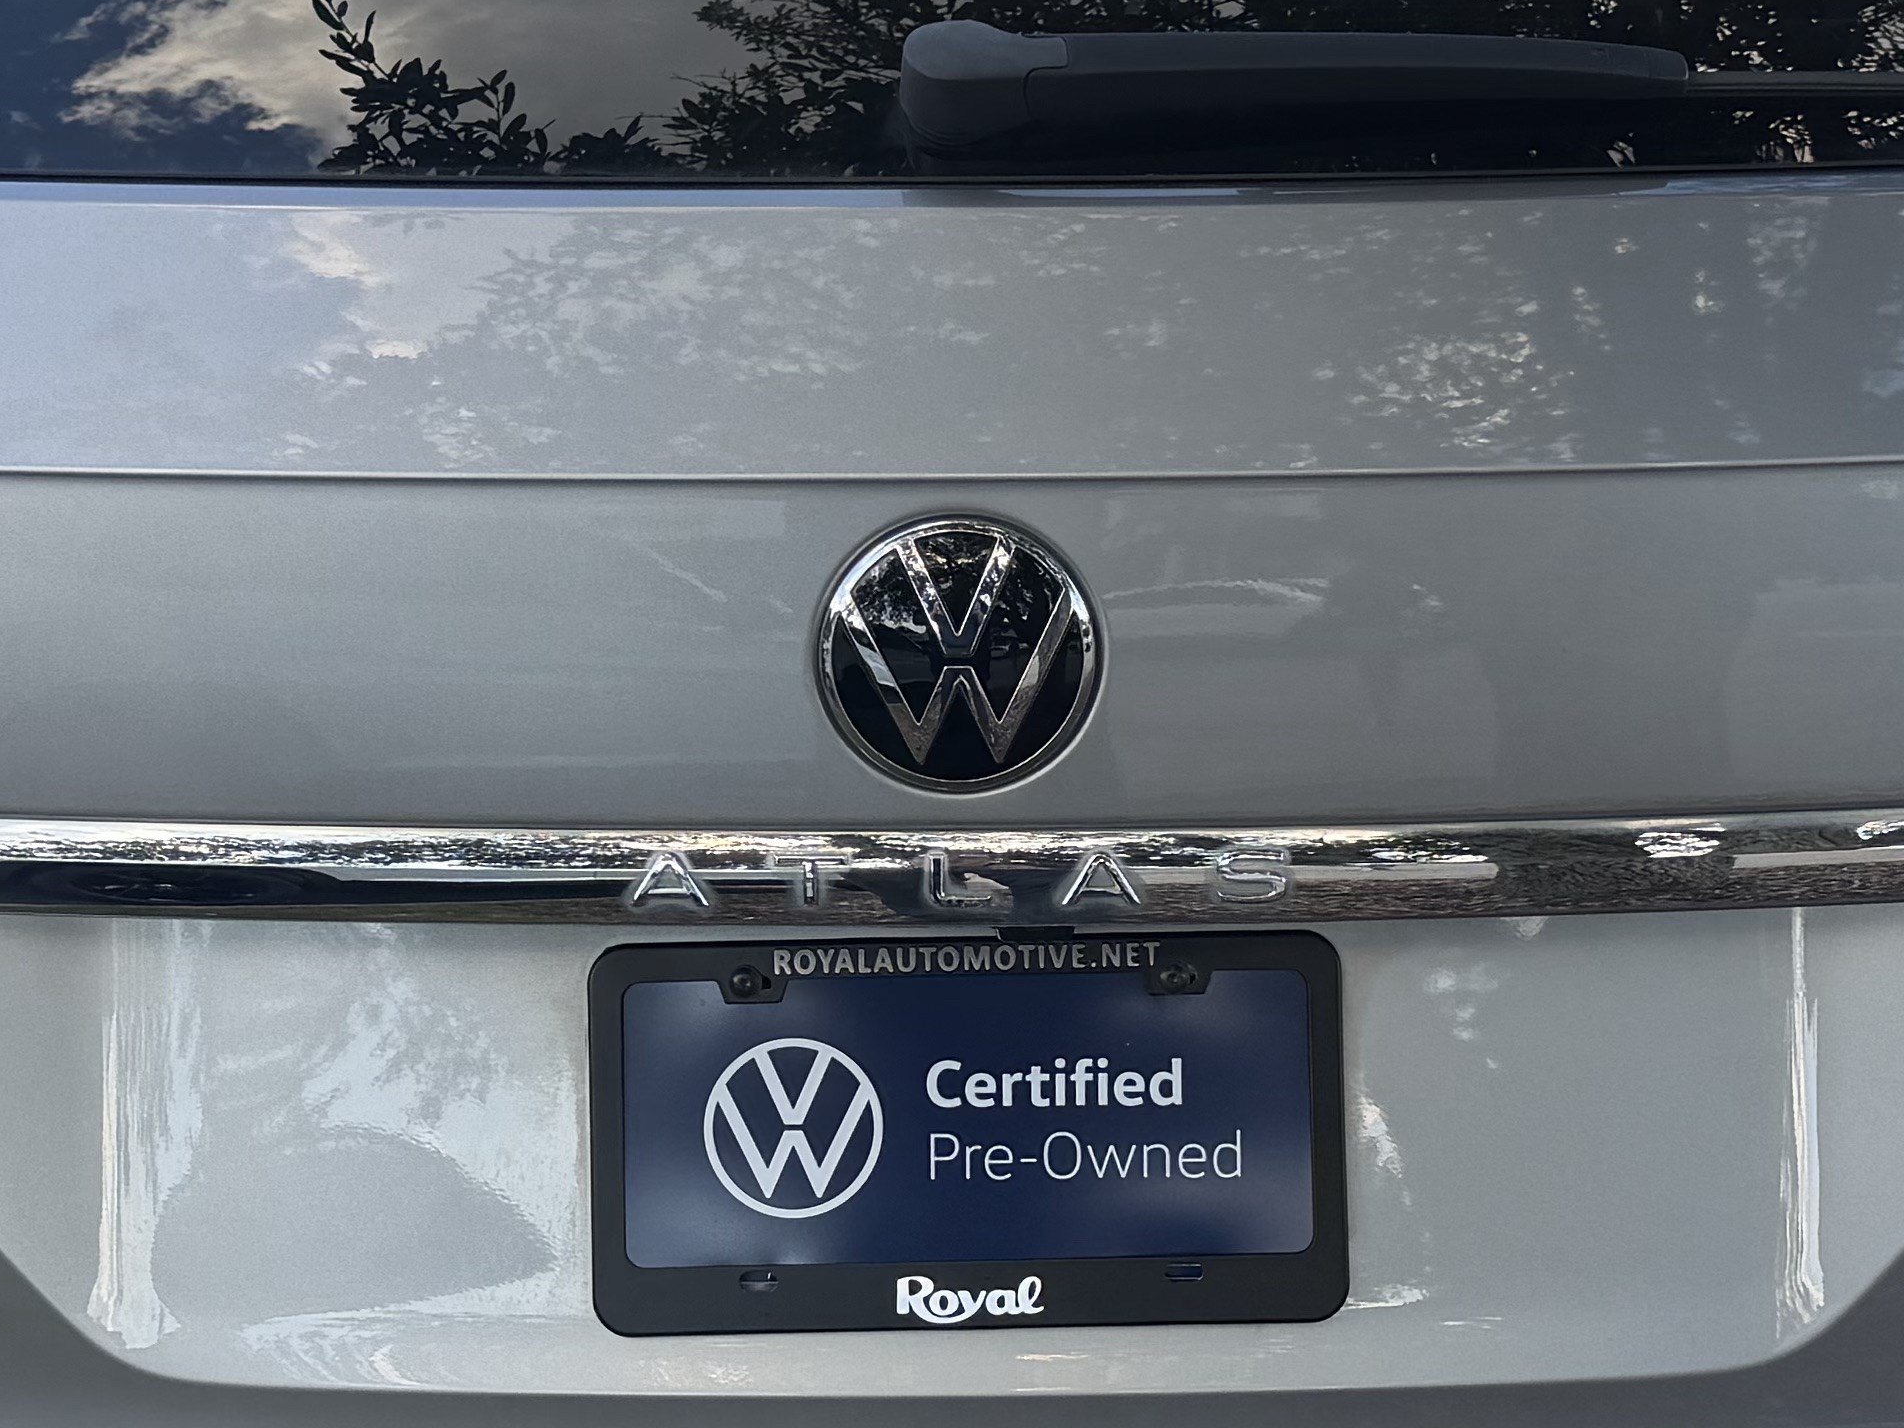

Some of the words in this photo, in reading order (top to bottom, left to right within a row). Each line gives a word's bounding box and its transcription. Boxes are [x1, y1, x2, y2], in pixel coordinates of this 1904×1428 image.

[630, 848, 1292, 907] ATLAS
[773, 941, 1162, 976] ROYALAUTOMOTIVE.NET
[926, 1058, 1184, 1109] Certified
[928, 1129, 1243, 1182] Pre-Owned
[896, 1275, 1046, 1325] Royal
